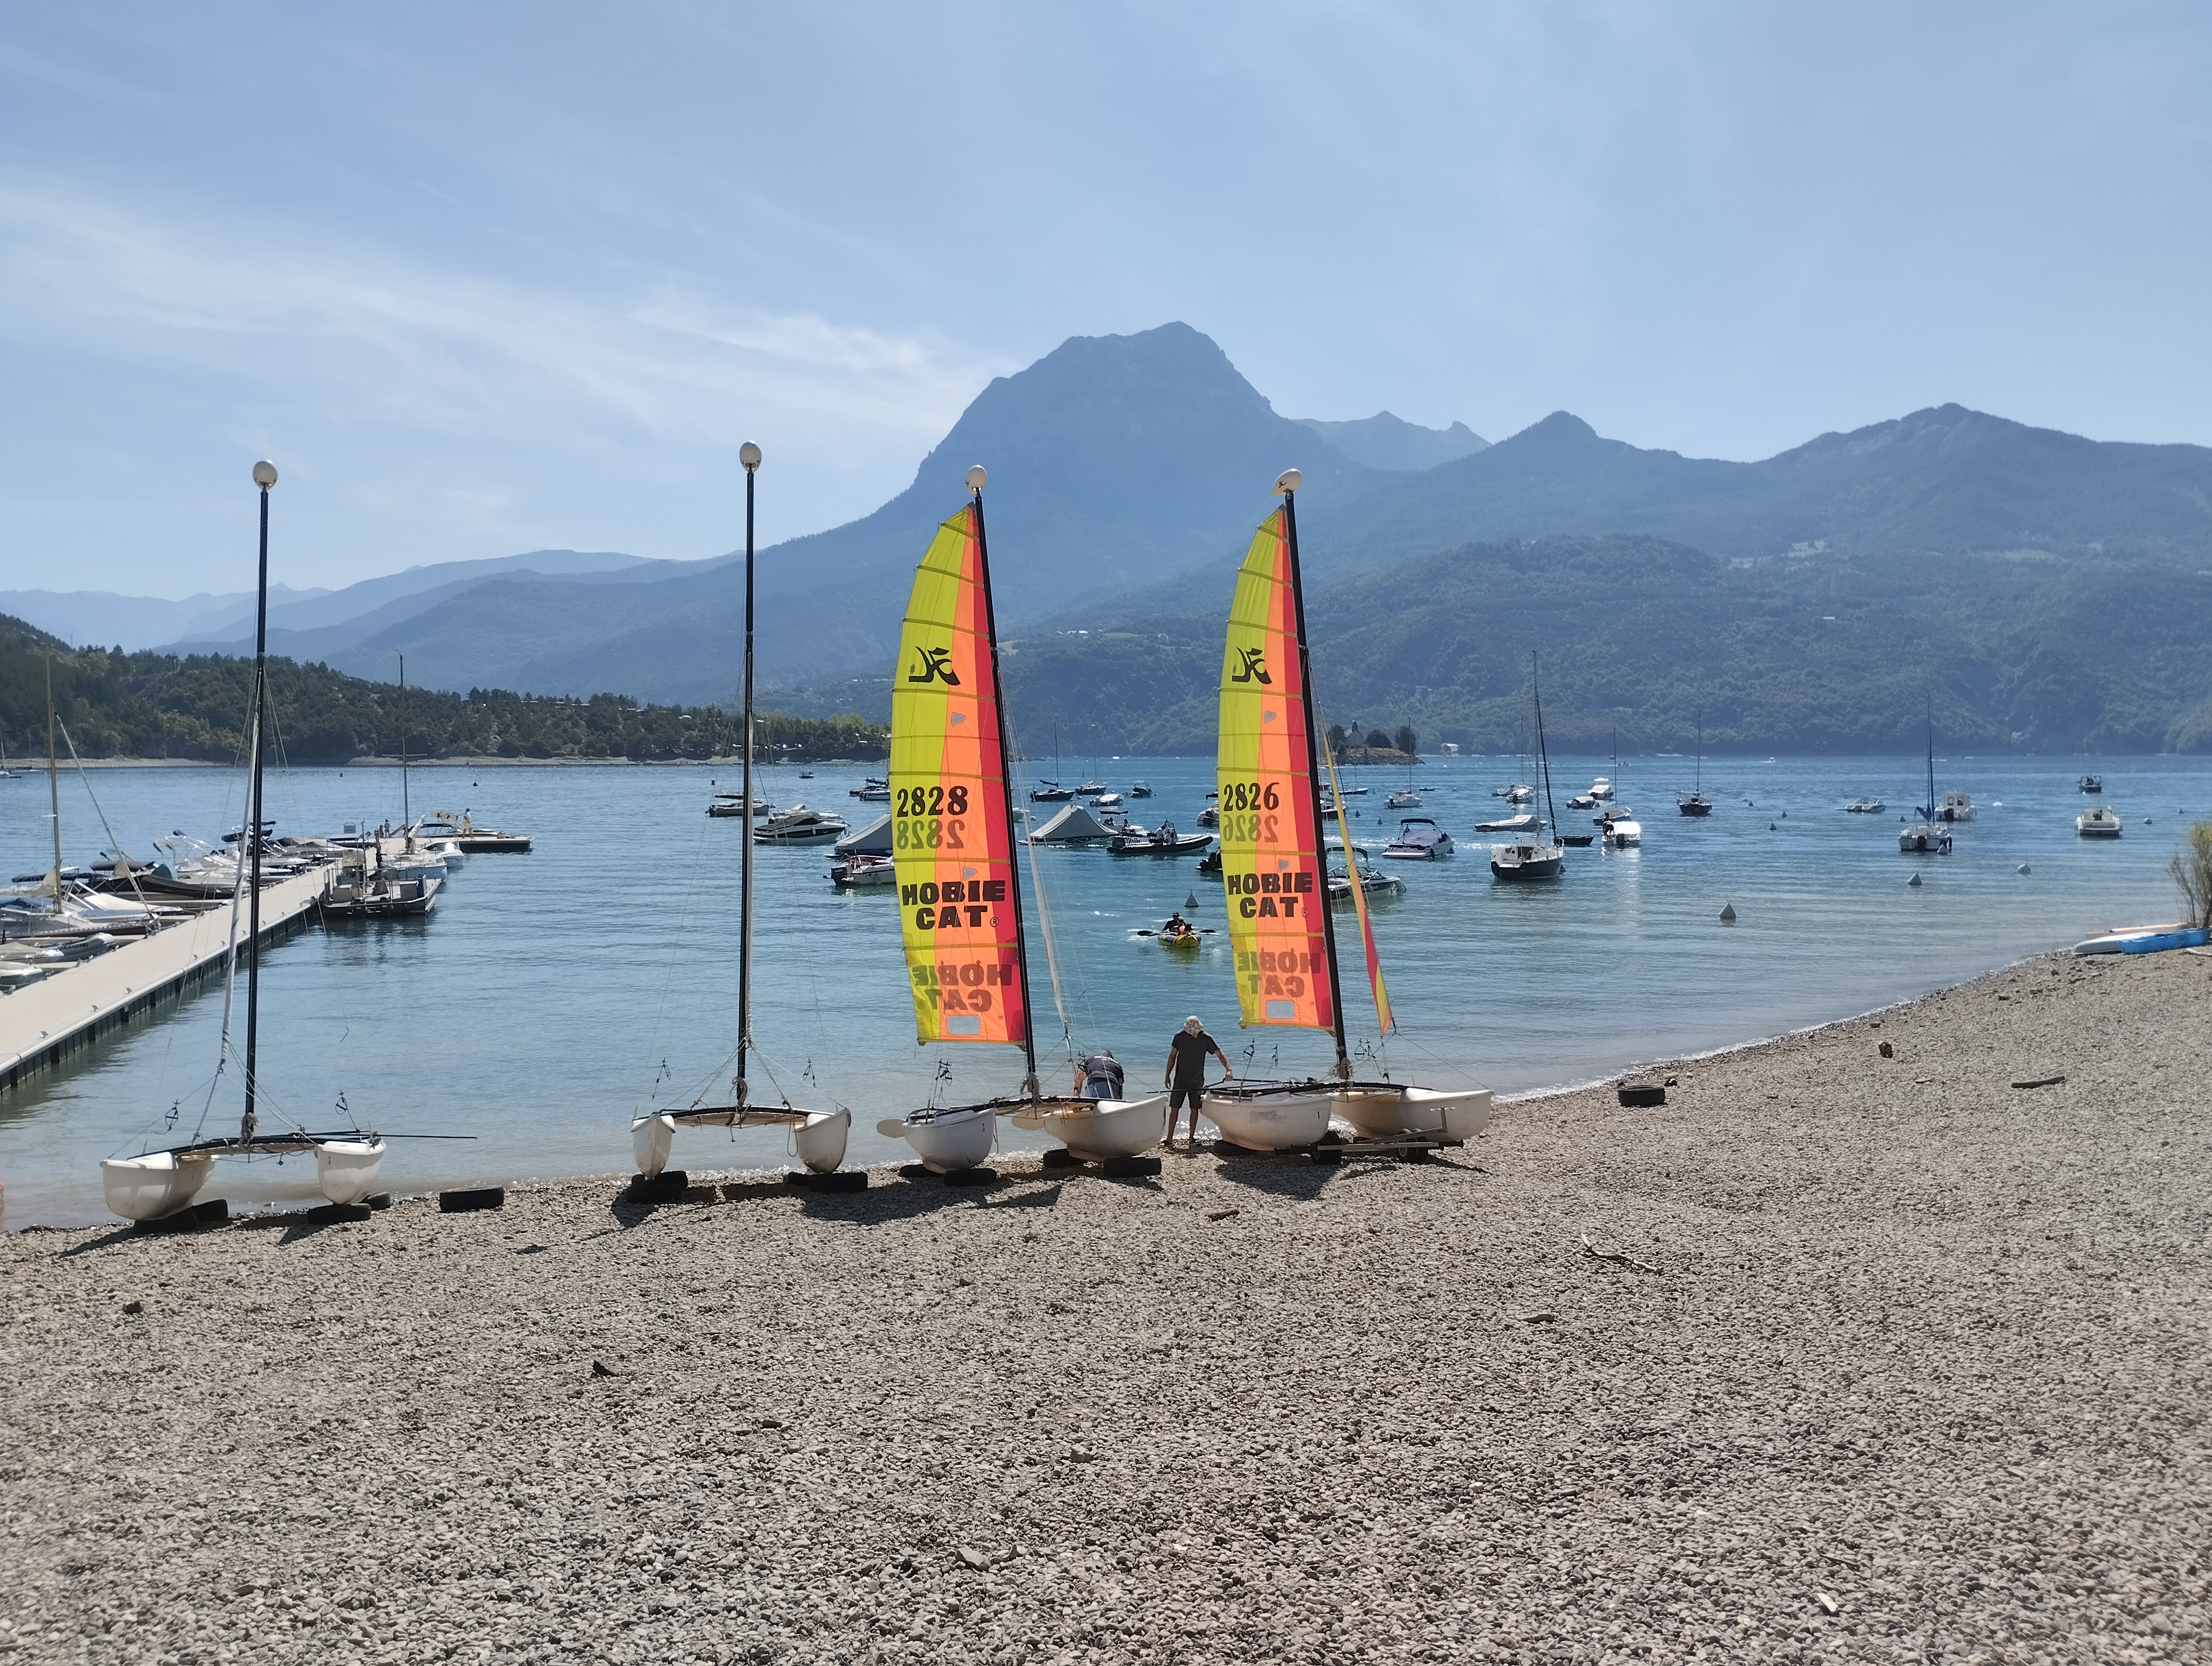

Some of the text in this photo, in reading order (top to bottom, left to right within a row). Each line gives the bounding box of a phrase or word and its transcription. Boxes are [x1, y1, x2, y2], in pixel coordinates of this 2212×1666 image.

[897, 786, 968, 817] 2828
[1224, 783, 1279, 811] 2826
[902, 880, 1005, 906] HOBIE
[1227, 873, 1312, 895] HOBIE
